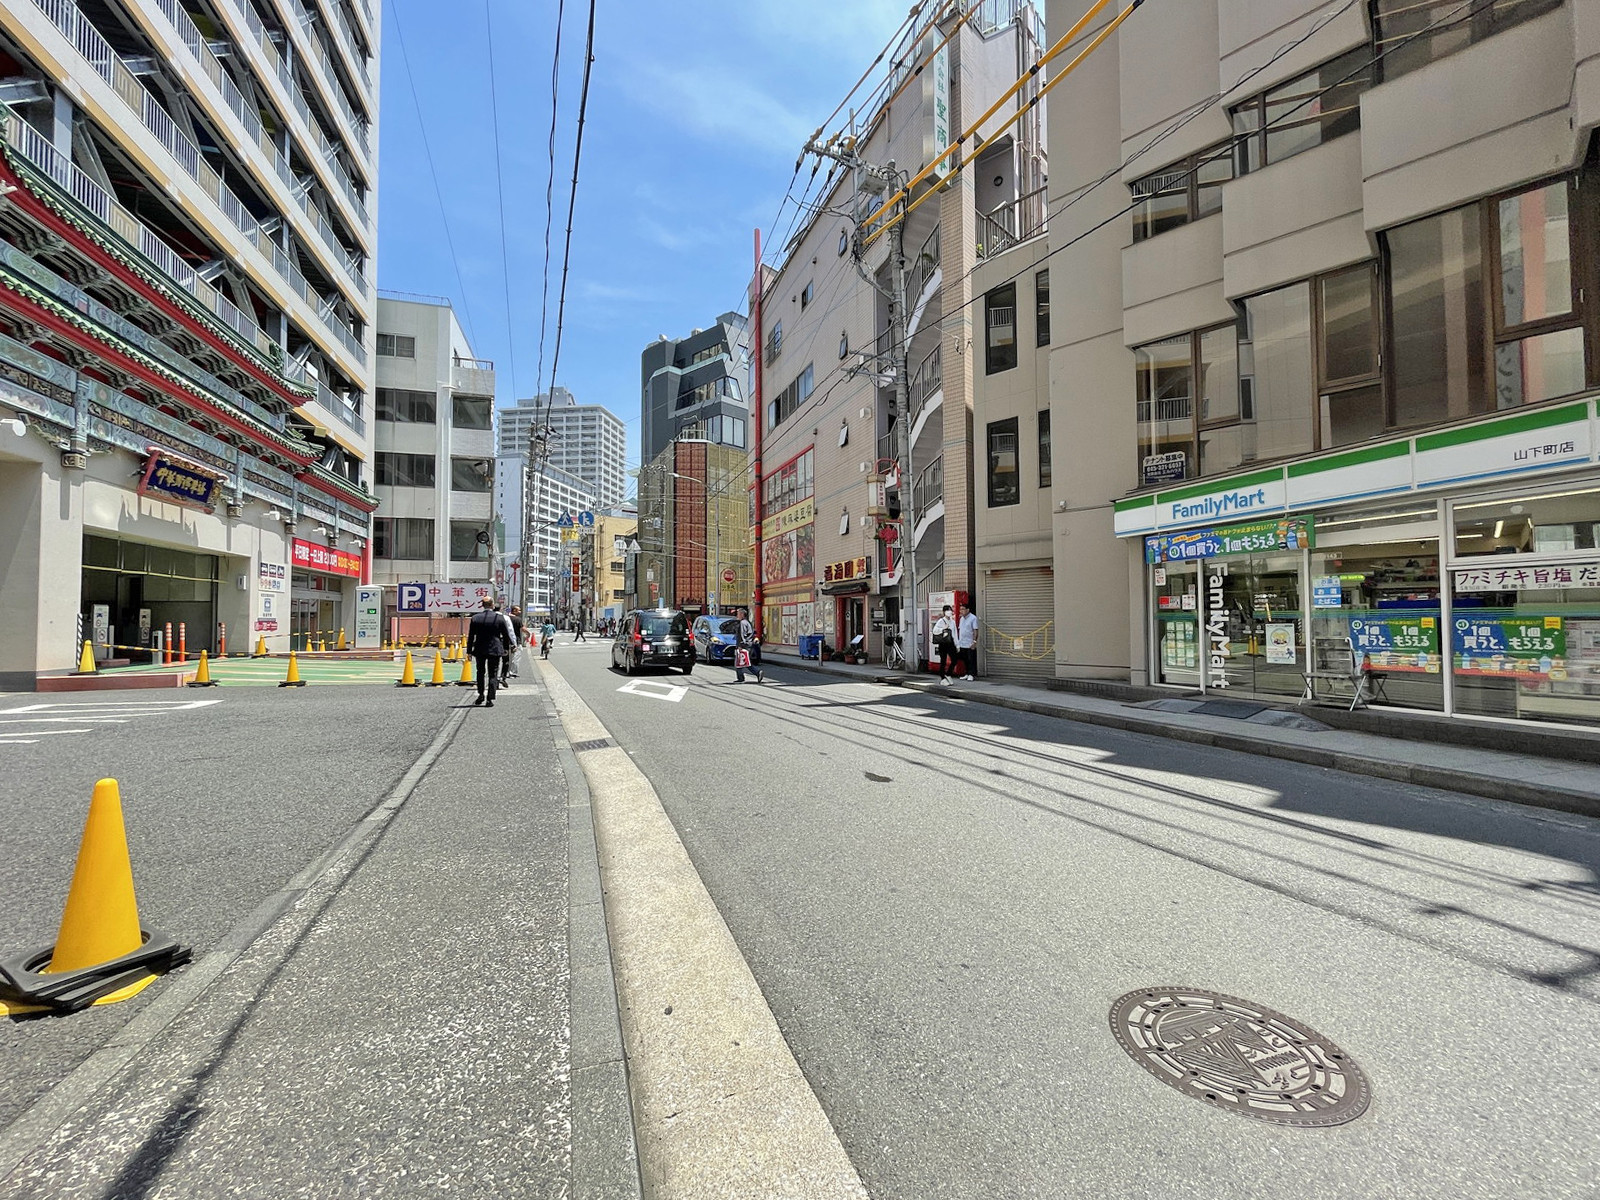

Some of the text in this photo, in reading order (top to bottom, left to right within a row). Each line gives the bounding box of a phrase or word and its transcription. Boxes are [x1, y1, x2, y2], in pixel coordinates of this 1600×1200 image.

[1514, 441, 1574, 461] 山下町店
[1145, 453, 1183, 465] テナント募集中
[1172, 488, 1265, 519] FamilyMart
[1457, 567, 1600, 586] ファミチキ旨塩 だ
[361, 592, 370, 602] P
[402, 586, 422, 609] P
[428, 587, 489, 598] 中華街
[409, 601, 422, 609] 24h
[1206, 562, 1231, 688] FamilyMart
[1363, 625, 1380, 635] 1個
[1401, 625, 1419, 636] 1個
[1471, 625, 1491, 636] 1個
[1519, 625, 1541, 637] 1個
[1358, 635, 1391, 647] 買うと、
[1393, 635, 1431, 647] もらえる
[1463, 636, 1505, 649] 買うと、
[1508, 637, 1555, 650] もらえる
